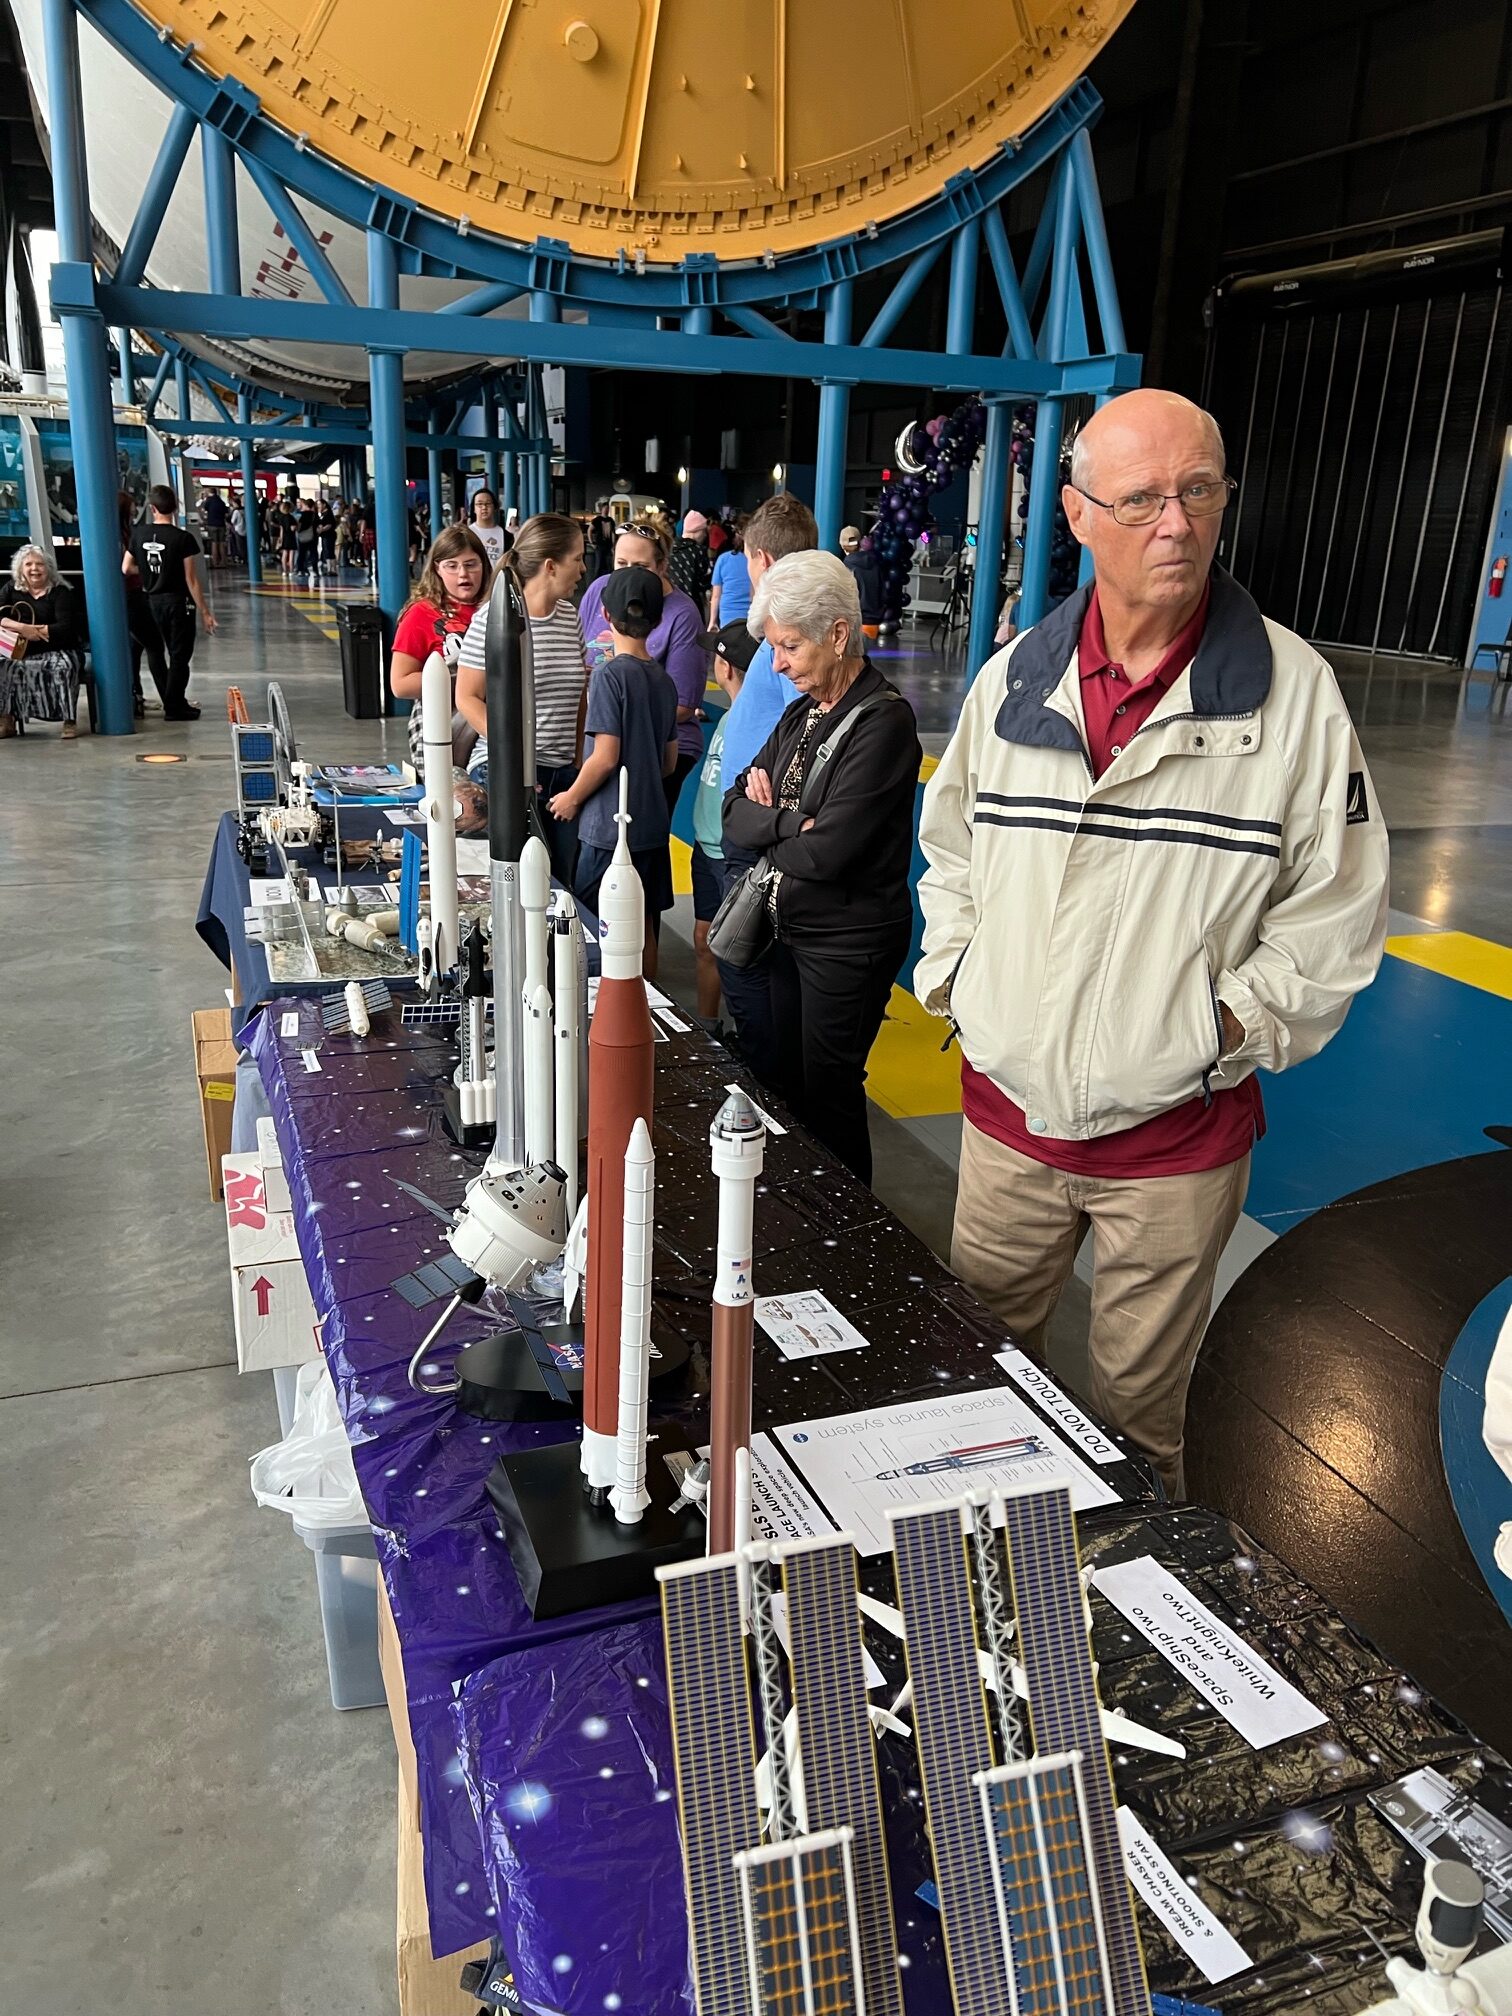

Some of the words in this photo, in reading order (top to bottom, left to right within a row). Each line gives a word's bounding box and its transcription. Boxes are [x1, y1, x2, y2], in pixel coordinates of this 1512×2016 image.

[560, 1343, 584, 1370] NASA
[1018, 1367, 1062, 1406] TOUCH
[888, 1408, 951, 1426] launch
[951, 1397, 1006, 1415] space
[817, 1418, 885, 1440] system
[1055, 1408, 1090, 1433] NOT
[1084, 1435, 1111, 1454] DO
[768, 1474, 783, 1492] space
[776, 1468, 794, 1490] vehicle
[753, 1480, 787, 1518] LAUNCH
[781, 1492, 795, 1508] deep
[792, 1489, 810, 1511] launch
[792, 1507, 805, 1521] new
[753, 1515, 779, 1539] SLS
[780, 1518, 803, 1541] ACE
[1132, 1607, 1234, 1706] SpaceShipTwo
[1162, 1592, 1276, 1700] WhiteKnightTwo
[1181, 1636, 1214, 1662] and
[1134, 1839, 1159, 1869] STAR
[1127, 1850, 1162, 1897] CHASER
[1156, 1870, 1205, 1928] SHOOTING
[1160, 1898, 1195, 1938] DREAM
[1203, 1928, 1214, 1938] &
[489, 1980, 520, 2004] GEMI
